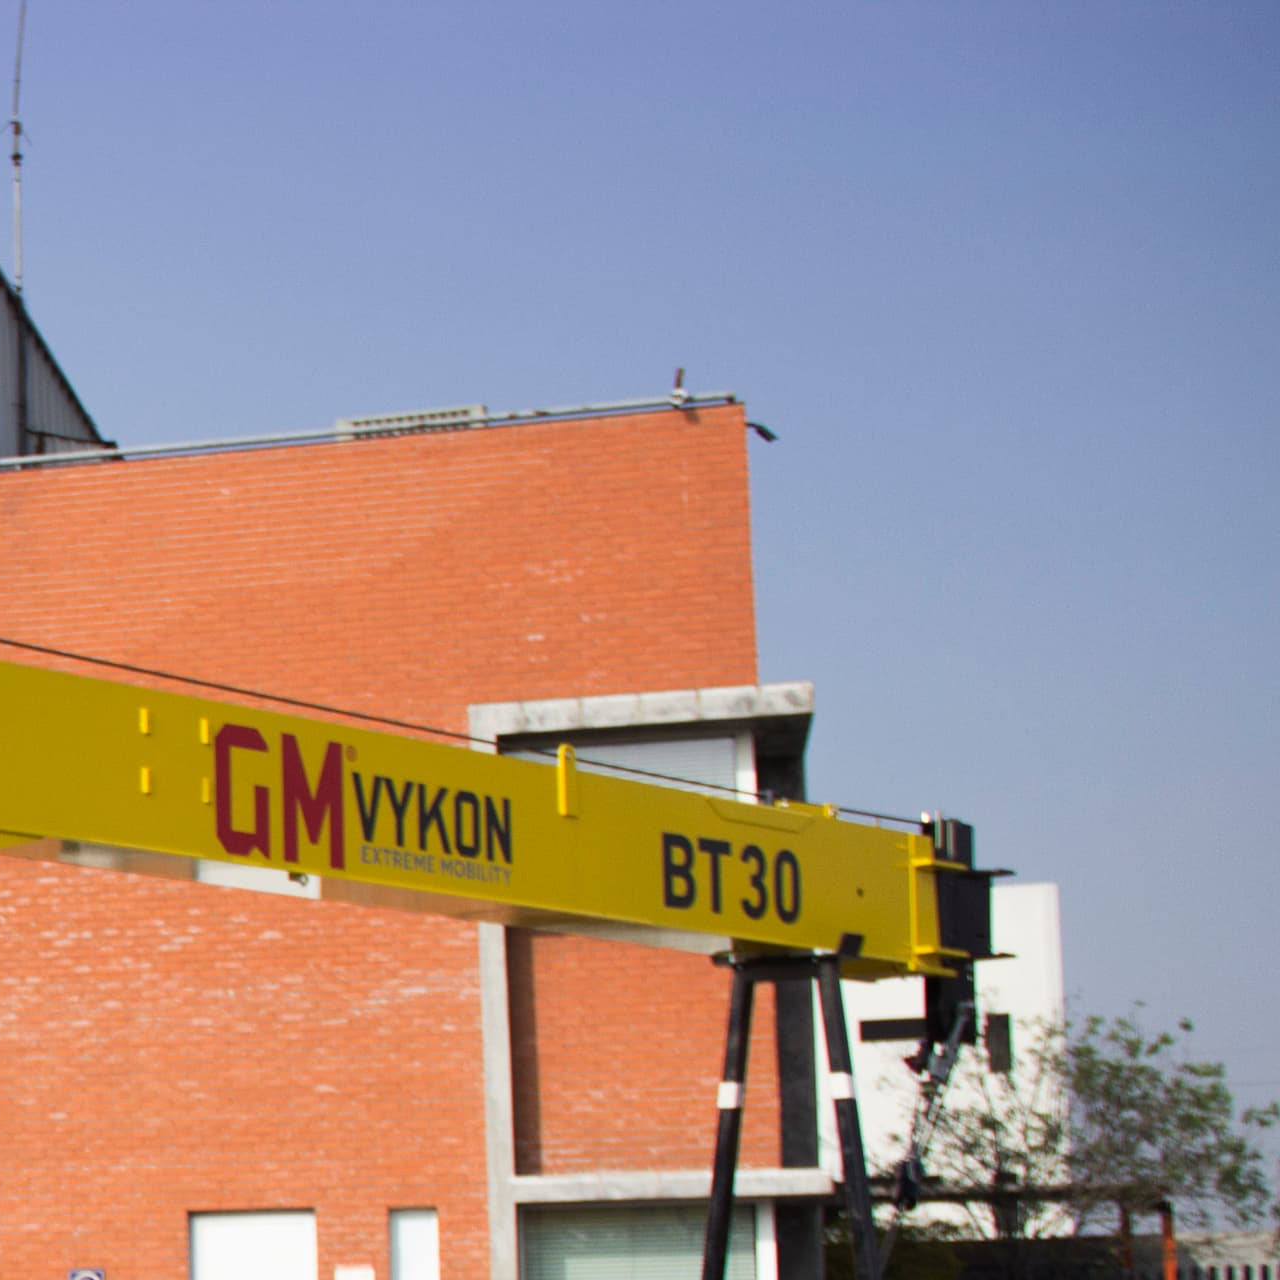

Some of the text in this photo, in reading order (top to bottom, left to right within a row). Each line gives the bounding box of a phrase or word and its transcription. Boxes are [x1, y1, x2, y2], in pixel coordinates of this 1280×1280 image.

[214, 723, 513, 870] GM VYKON
[359, 845, 514, 886] EXTREME MOBILITY
